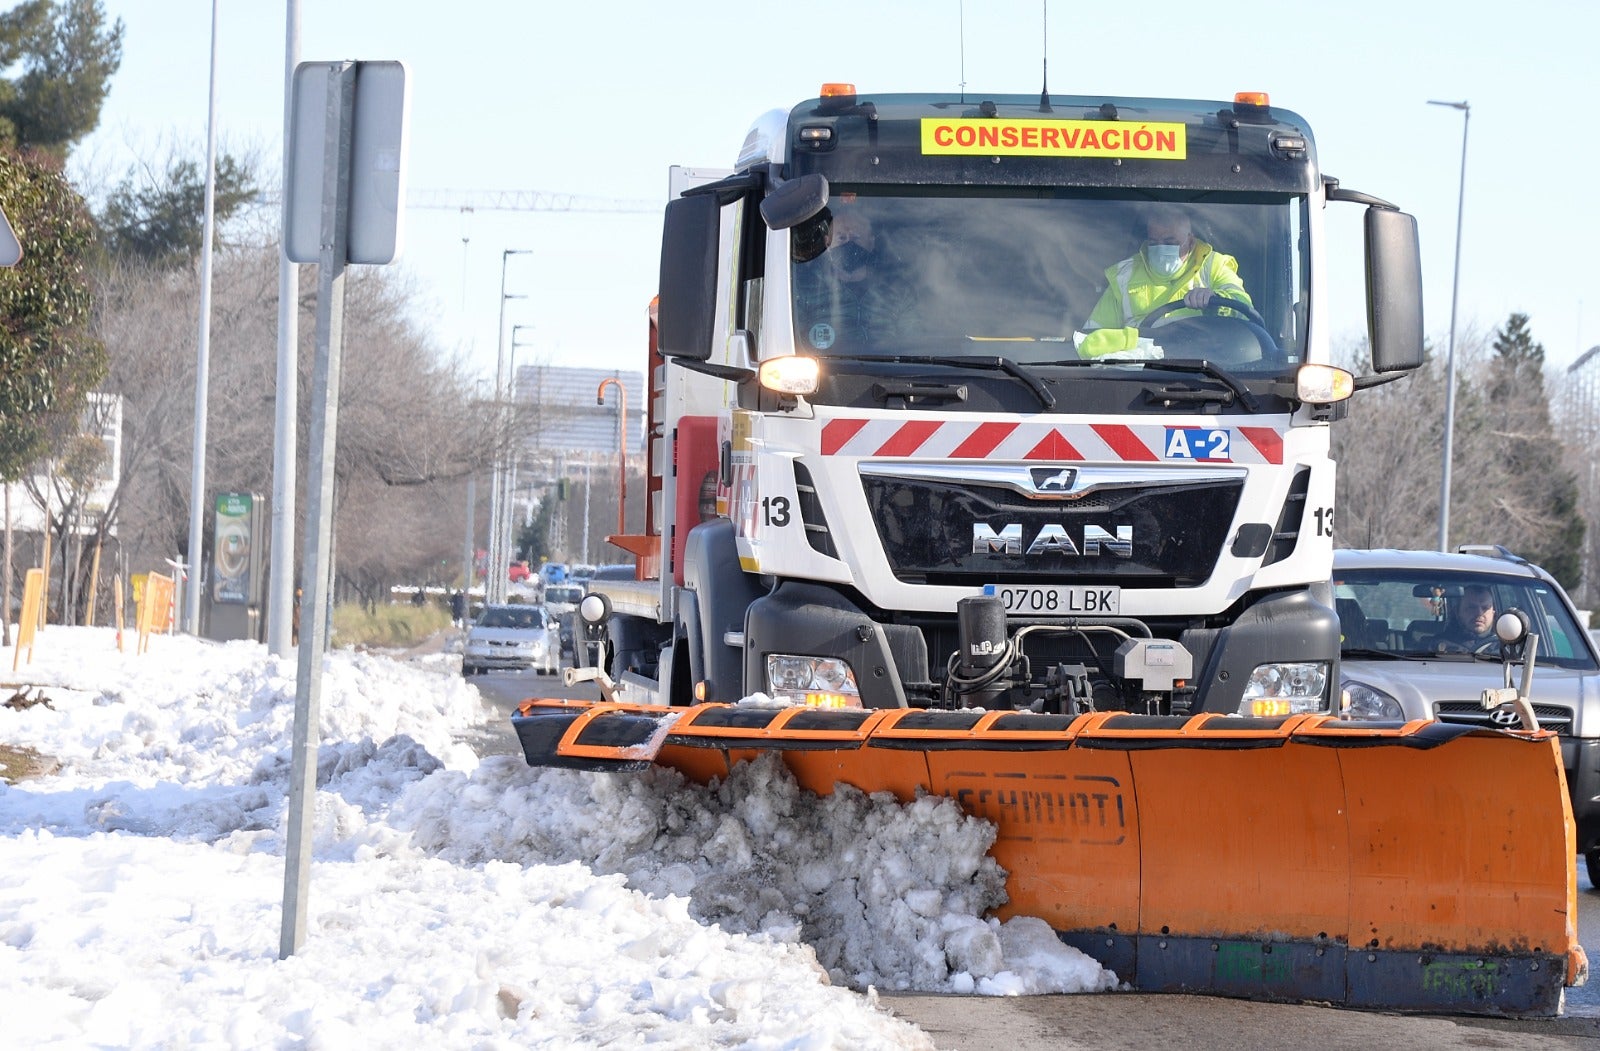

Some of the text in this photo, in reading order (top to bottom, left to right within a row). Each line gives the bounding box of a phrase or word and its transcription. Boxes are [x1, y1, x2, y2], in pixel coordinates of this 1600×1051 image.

[934, 125, 1176, 152] CONSERVACIÓN
[1166, 429, 1229, 459] A-2
[762, 496, 791, 527] 13
[973, 523, 1133, 557] MAN
[1001, 589, 1113, 612] 0708 LBK
